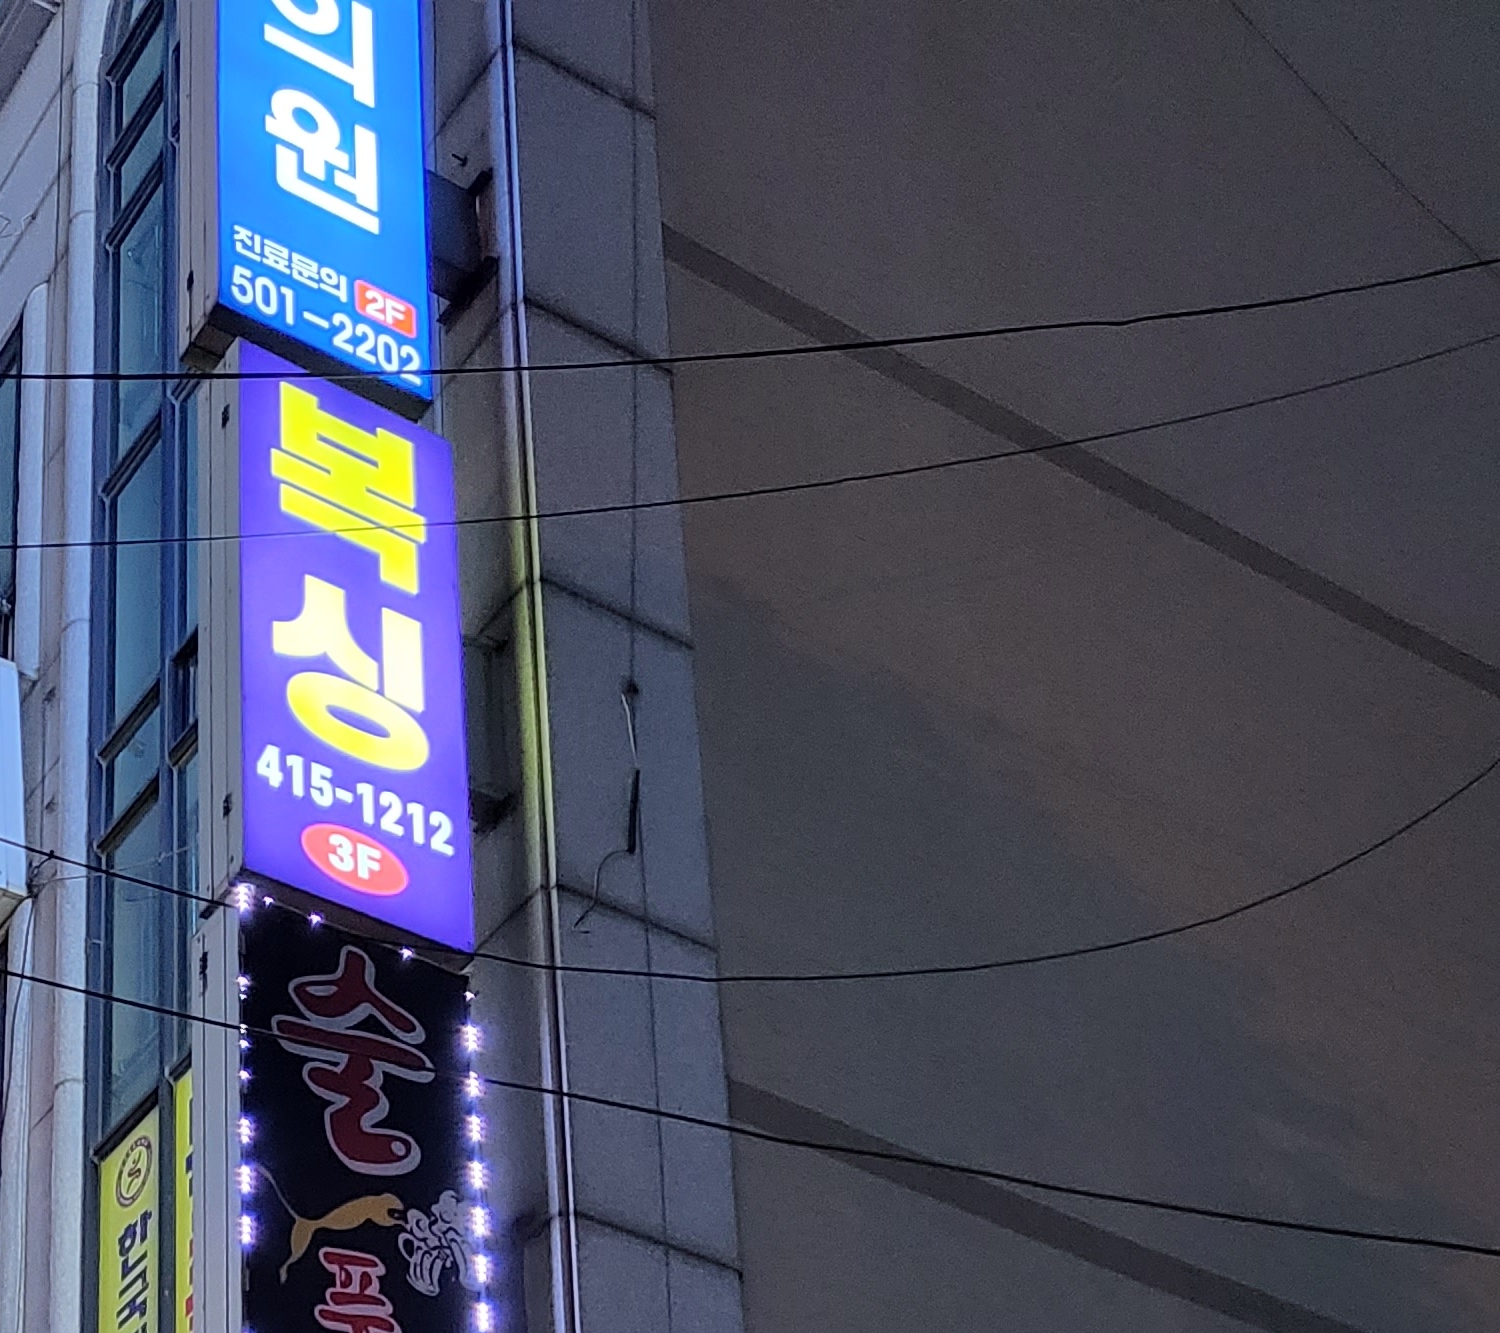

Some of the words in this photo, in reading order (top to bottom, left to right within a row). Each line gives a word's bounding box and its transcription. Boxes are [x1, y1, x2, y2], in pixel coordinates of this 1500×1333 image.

[233, 224, 348, 303] 진료문의
[364, 288, 408, 324] 2F
[231, 264, 423, 385] 501-2202
[270, 381, 430, 771] 복싱
[257, 744, 456, 857] 415-1212
[328, 833, 382, 880] 3F
